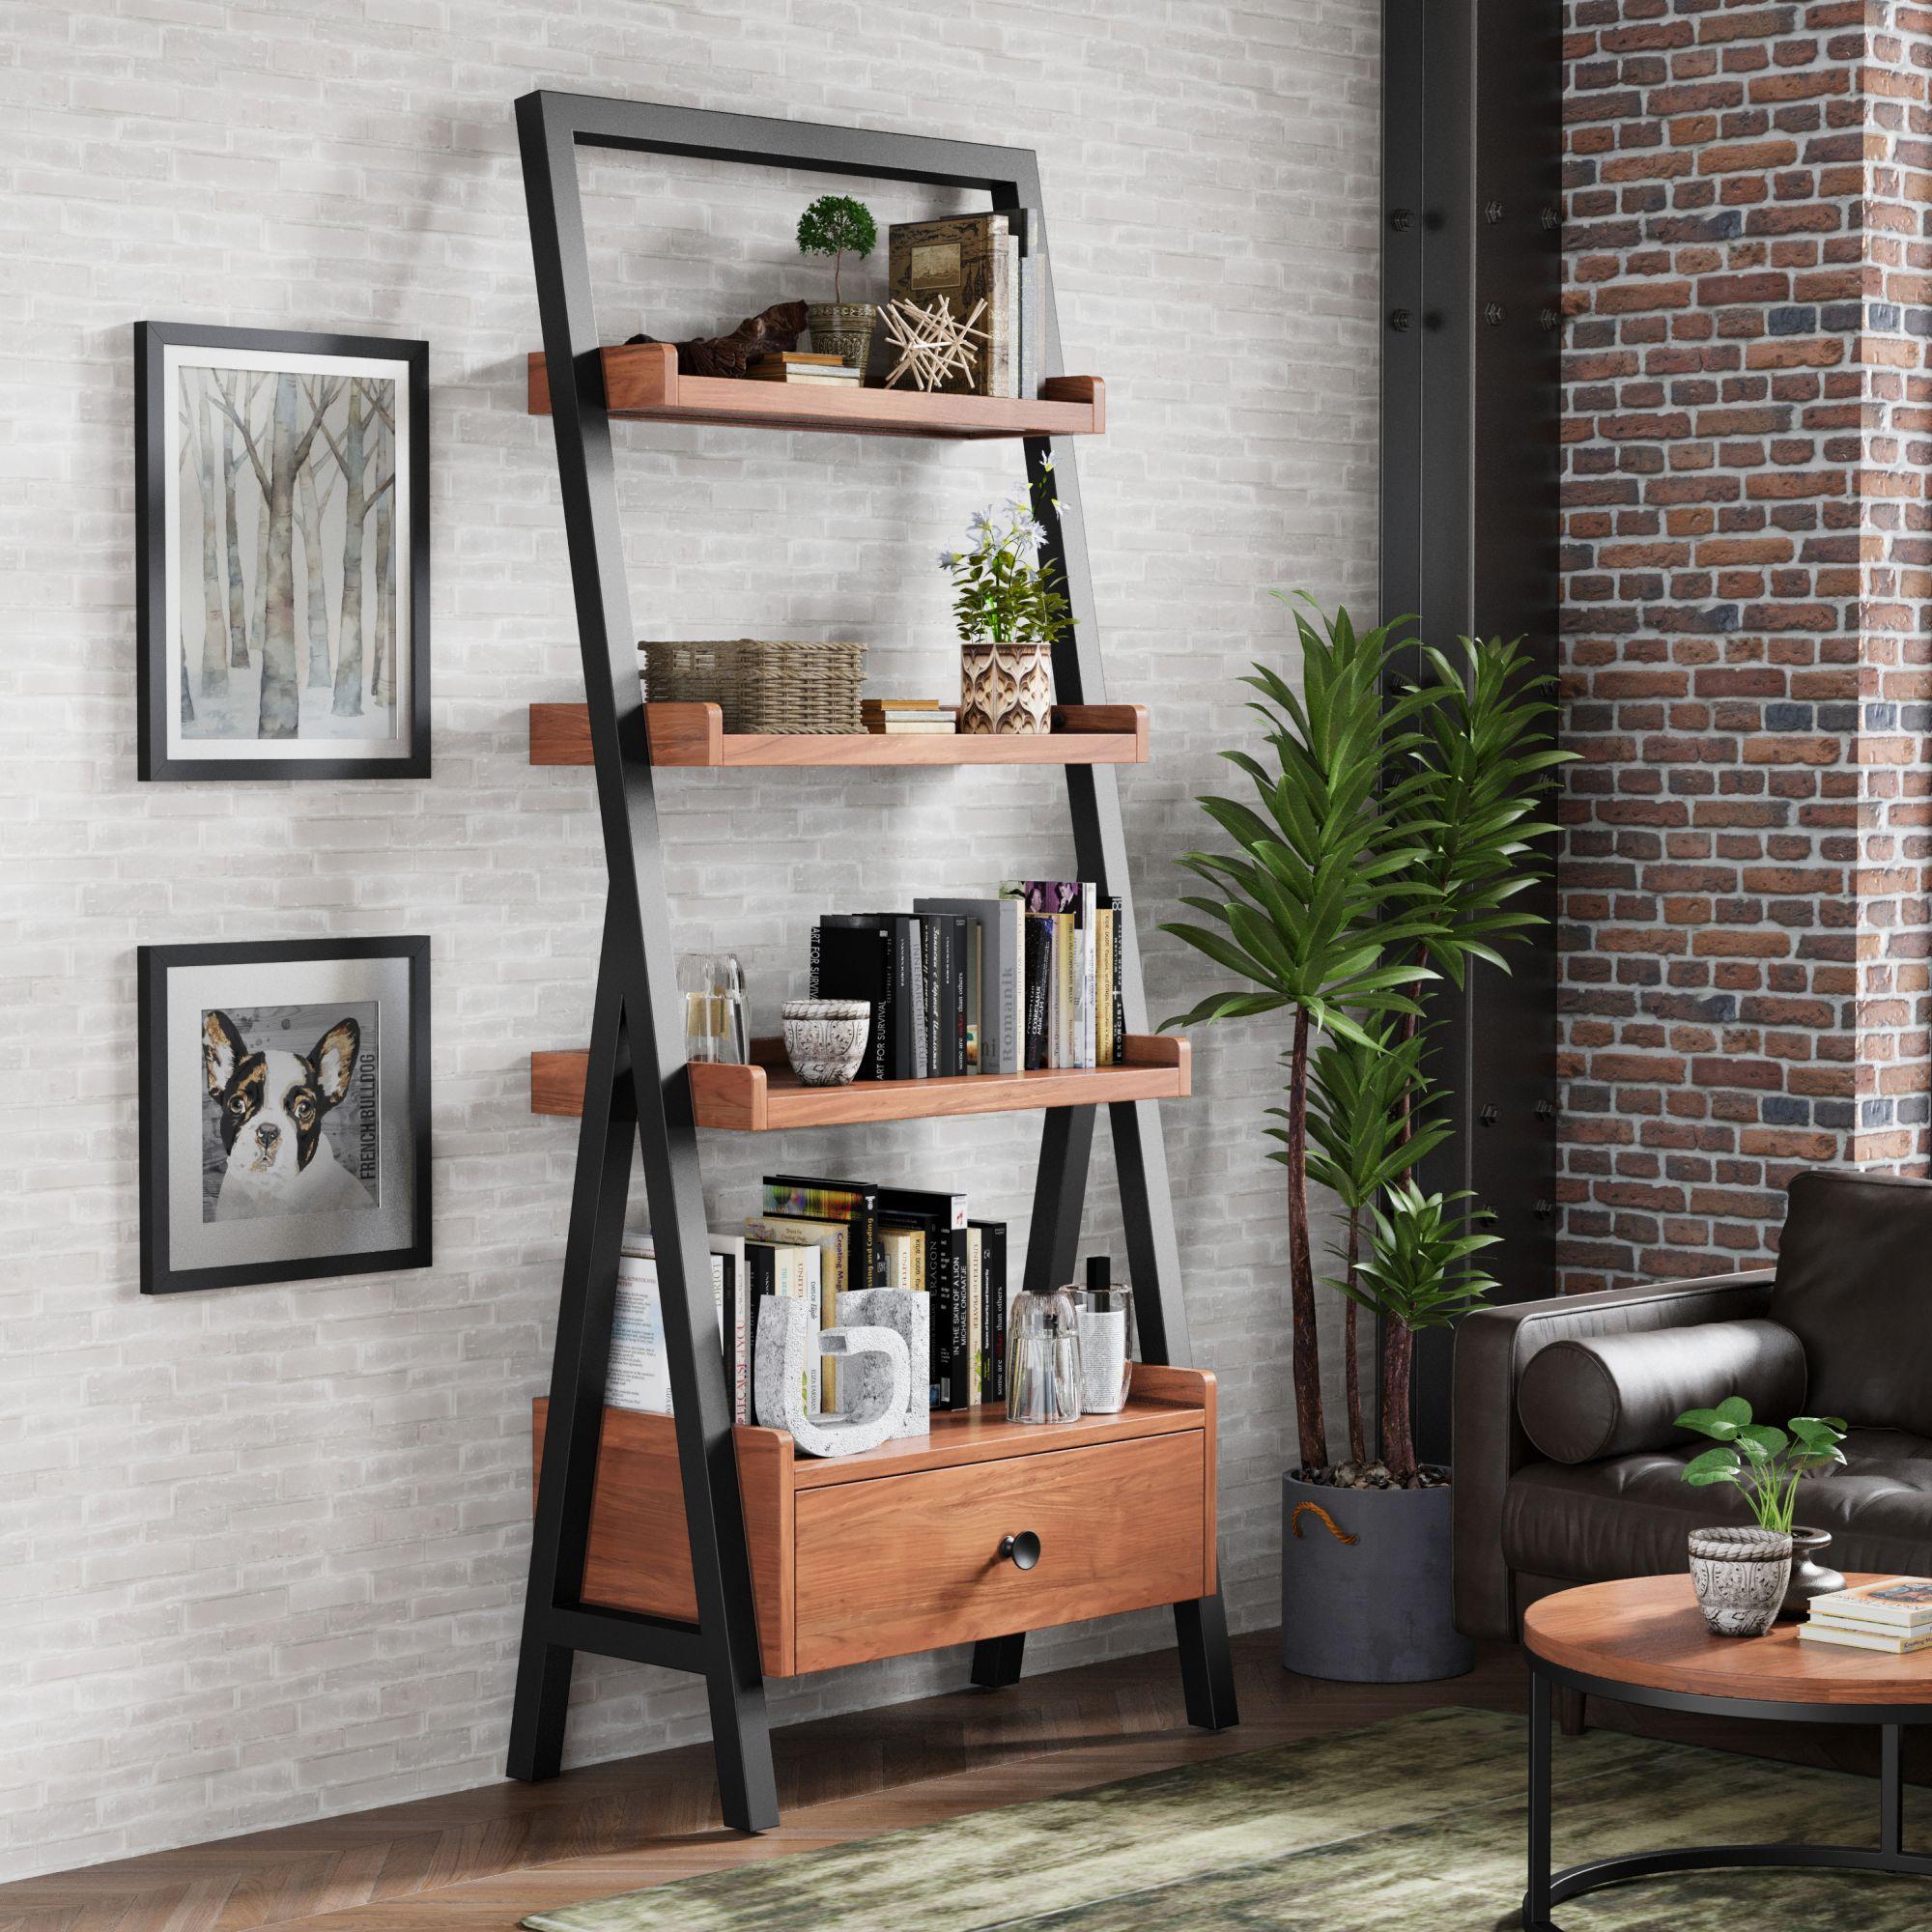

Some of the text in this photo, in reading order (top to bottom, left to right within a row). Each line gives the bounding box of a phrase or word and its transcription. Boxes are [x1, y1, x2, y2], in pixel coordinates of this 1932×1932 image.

[810, 927, 820, 1002] ART FOR SURVIVA
[876, 1000, 886, 1080] ART FOR SURVIVAL
[913, 944, 926, 1068] INNENARCHITEKTUR
[1002, 967, 1012, 1061] Romanik
[359, 1054, 376, 1179] FRENCH BULLDOG
[836, 1233, 844, 1268] Creating
[952, 1289, 960, 1301] OF
[952, 1346, 960, 1355] IN
